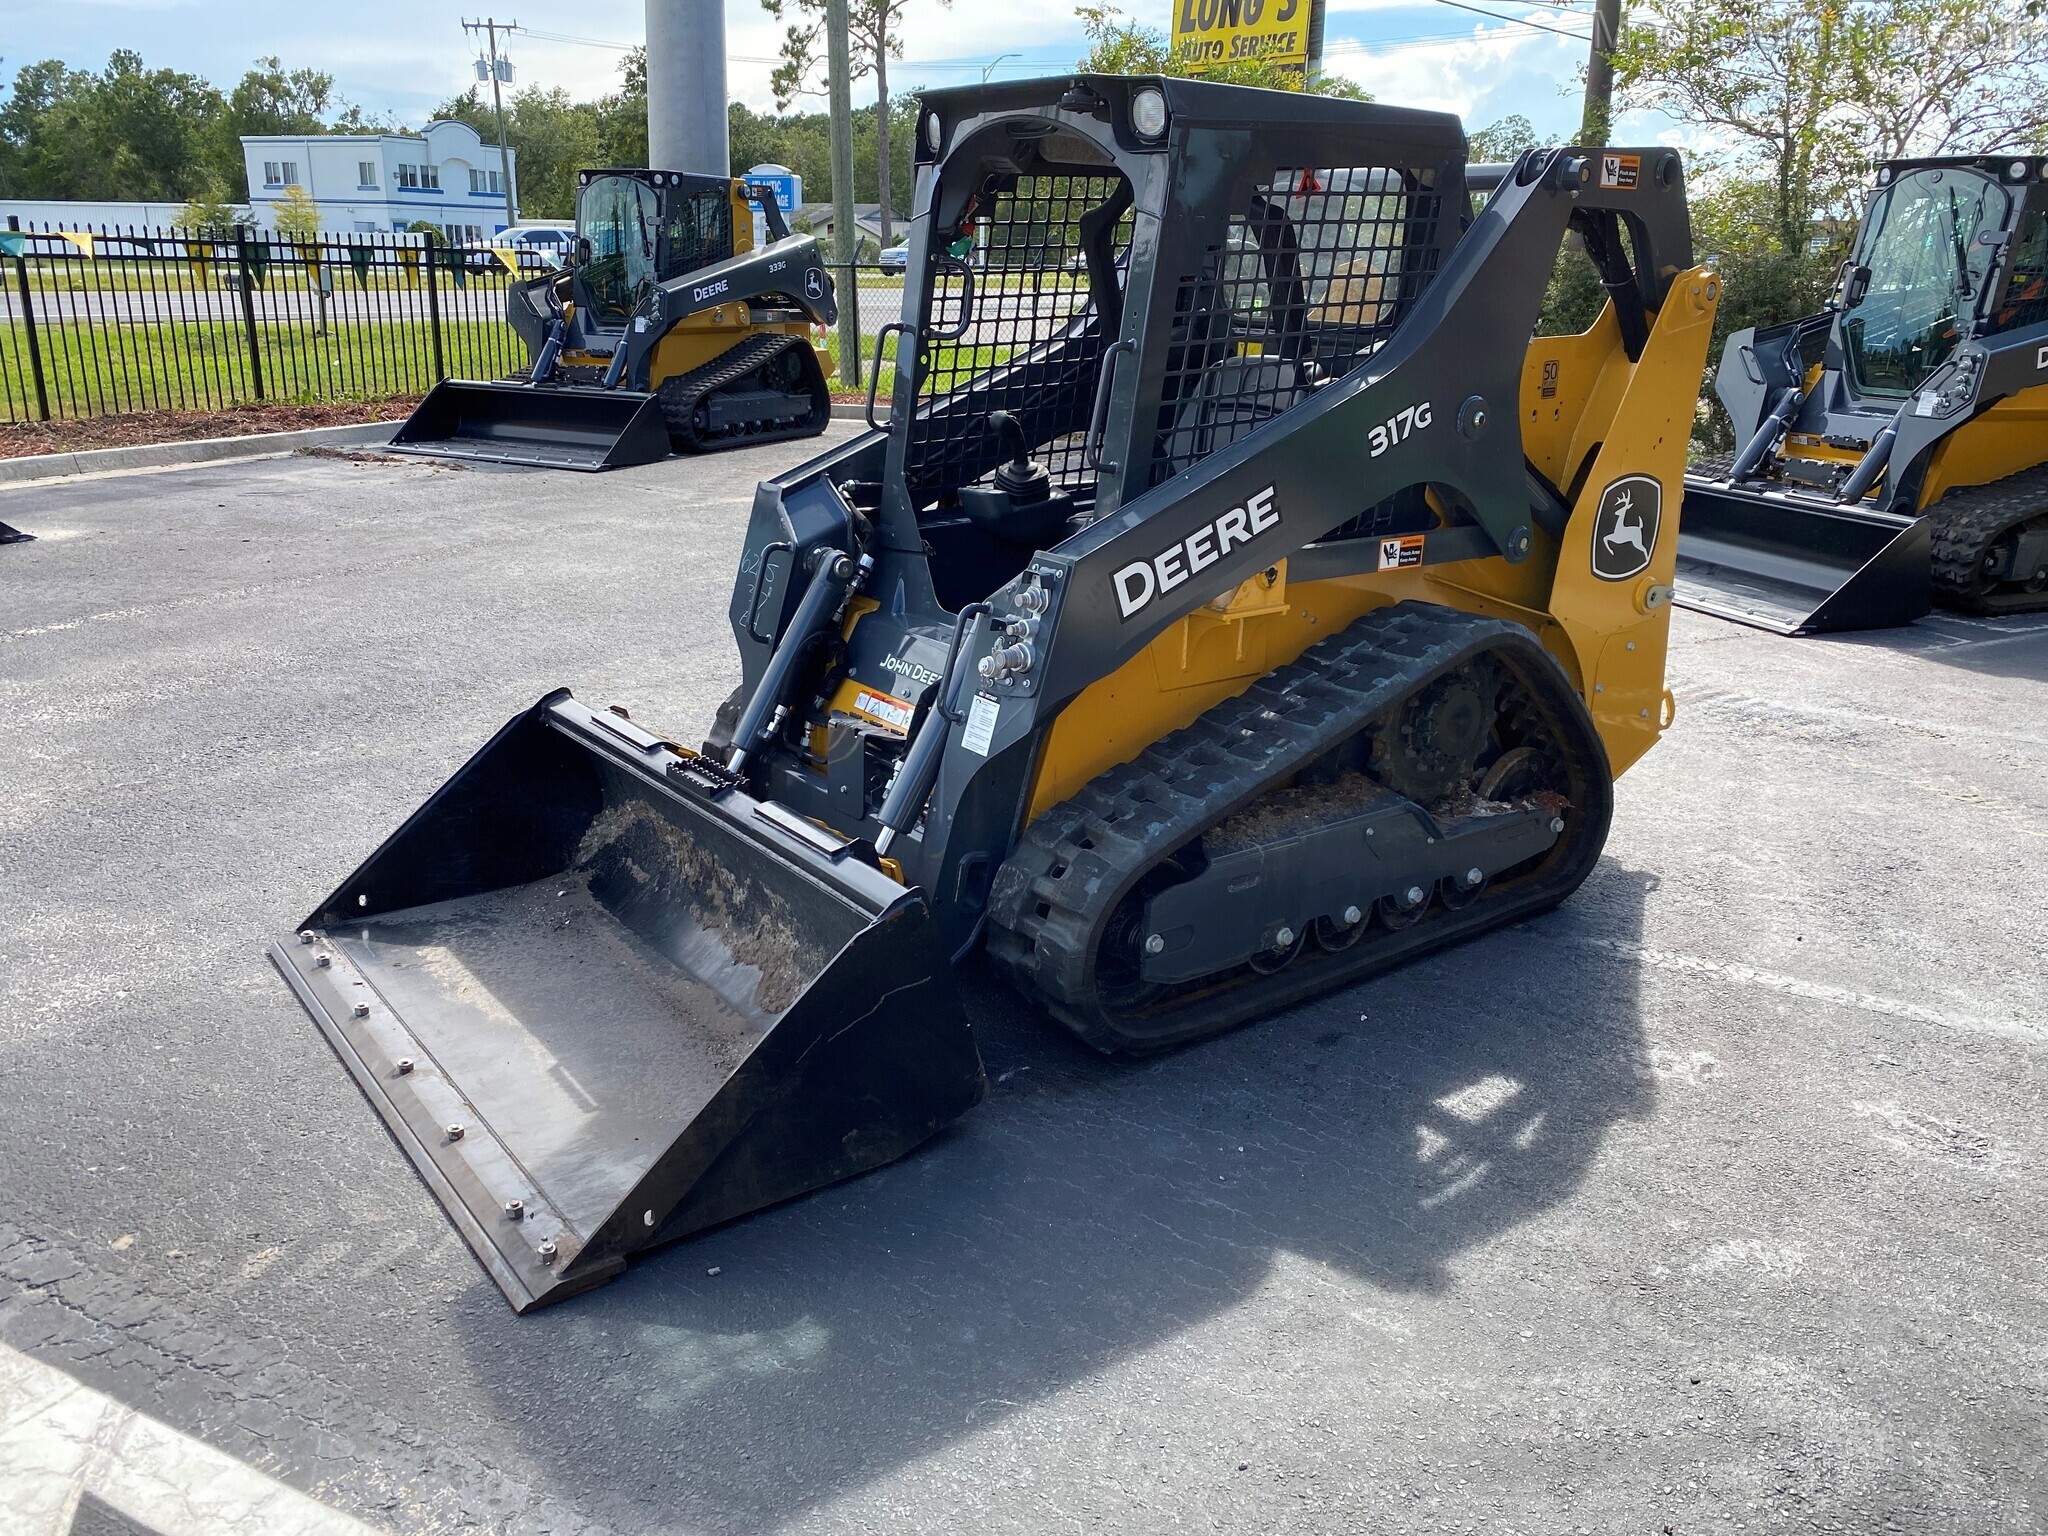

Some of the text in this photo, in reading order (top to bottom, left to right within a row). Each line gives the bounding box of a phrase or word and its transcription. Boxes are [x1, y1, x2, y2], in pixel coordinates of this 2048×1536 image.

[1179, 0, 1298, 33] LONGS
[768, 260, 787, 274] 333G
[693, 279, 729, 302] DEERE
[1544, 362, 1558, 381] 50
[1367, 402, 1433, 458] 317G
[1113, 485, 1280, 618] DEERE
[880, 653, 943, 686] JOHN DEE
